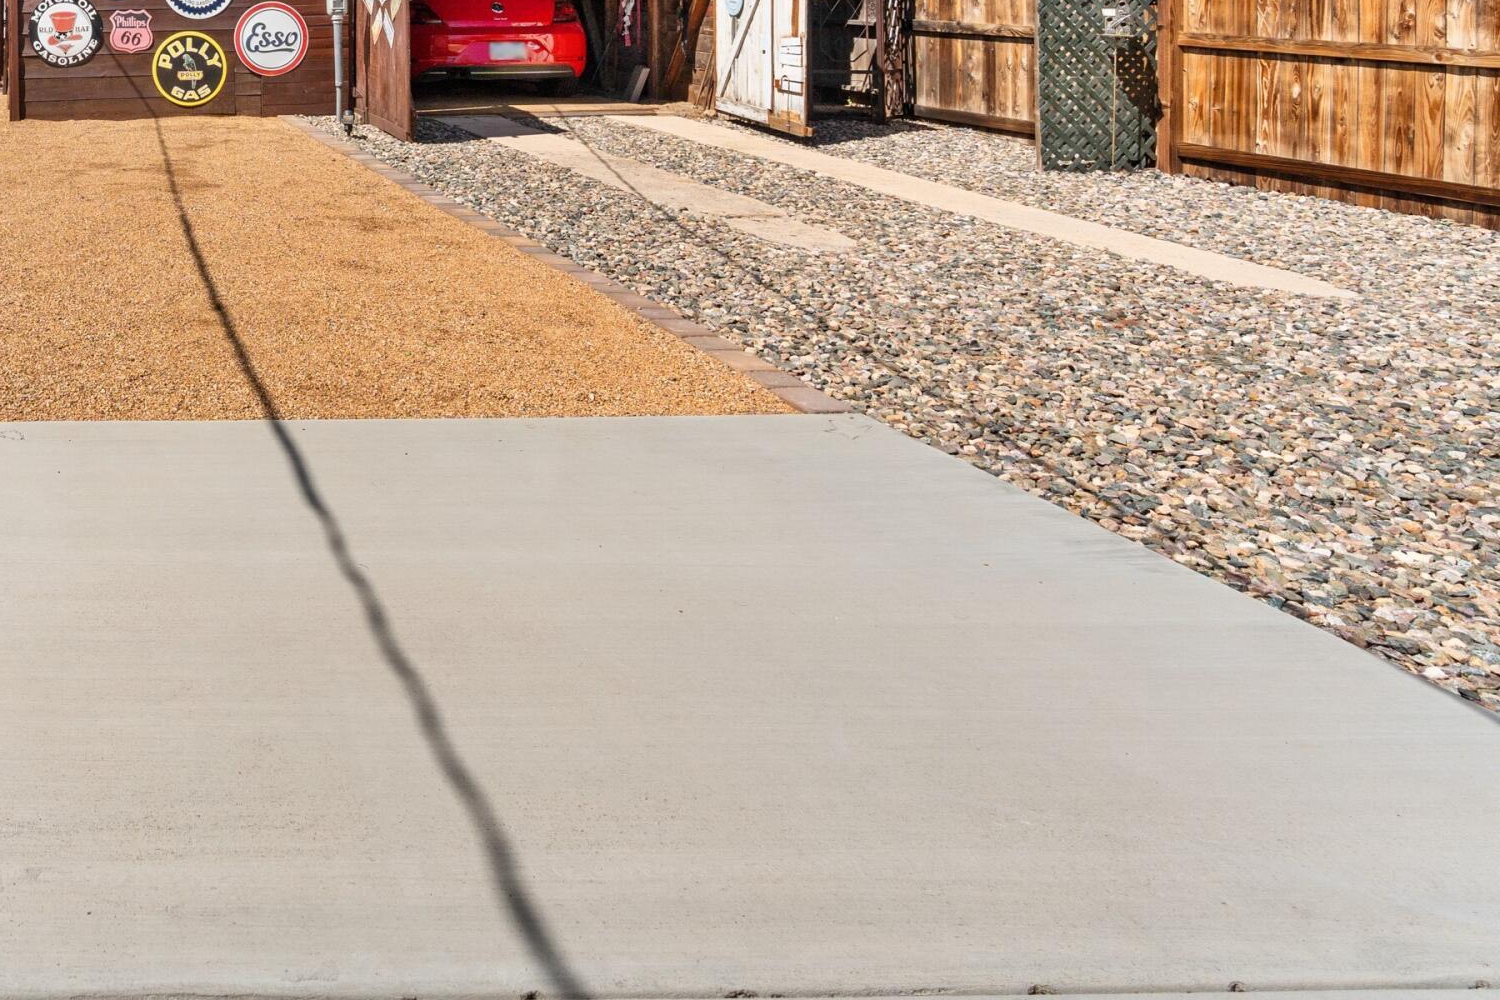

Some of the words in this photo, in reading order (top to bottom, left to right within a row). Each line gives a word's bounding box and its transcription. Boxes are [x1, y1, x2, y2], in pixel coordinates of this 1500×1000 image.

[114, 15, 147, 29] Phillips
[120, 30, 143, 46] 66
[245, 22, 299, 54] Esso
[32, 38, 98, 66] GASOLINE
[157, 37, 223, 70] POLLY
[170, 83, 212, 101] GAS
